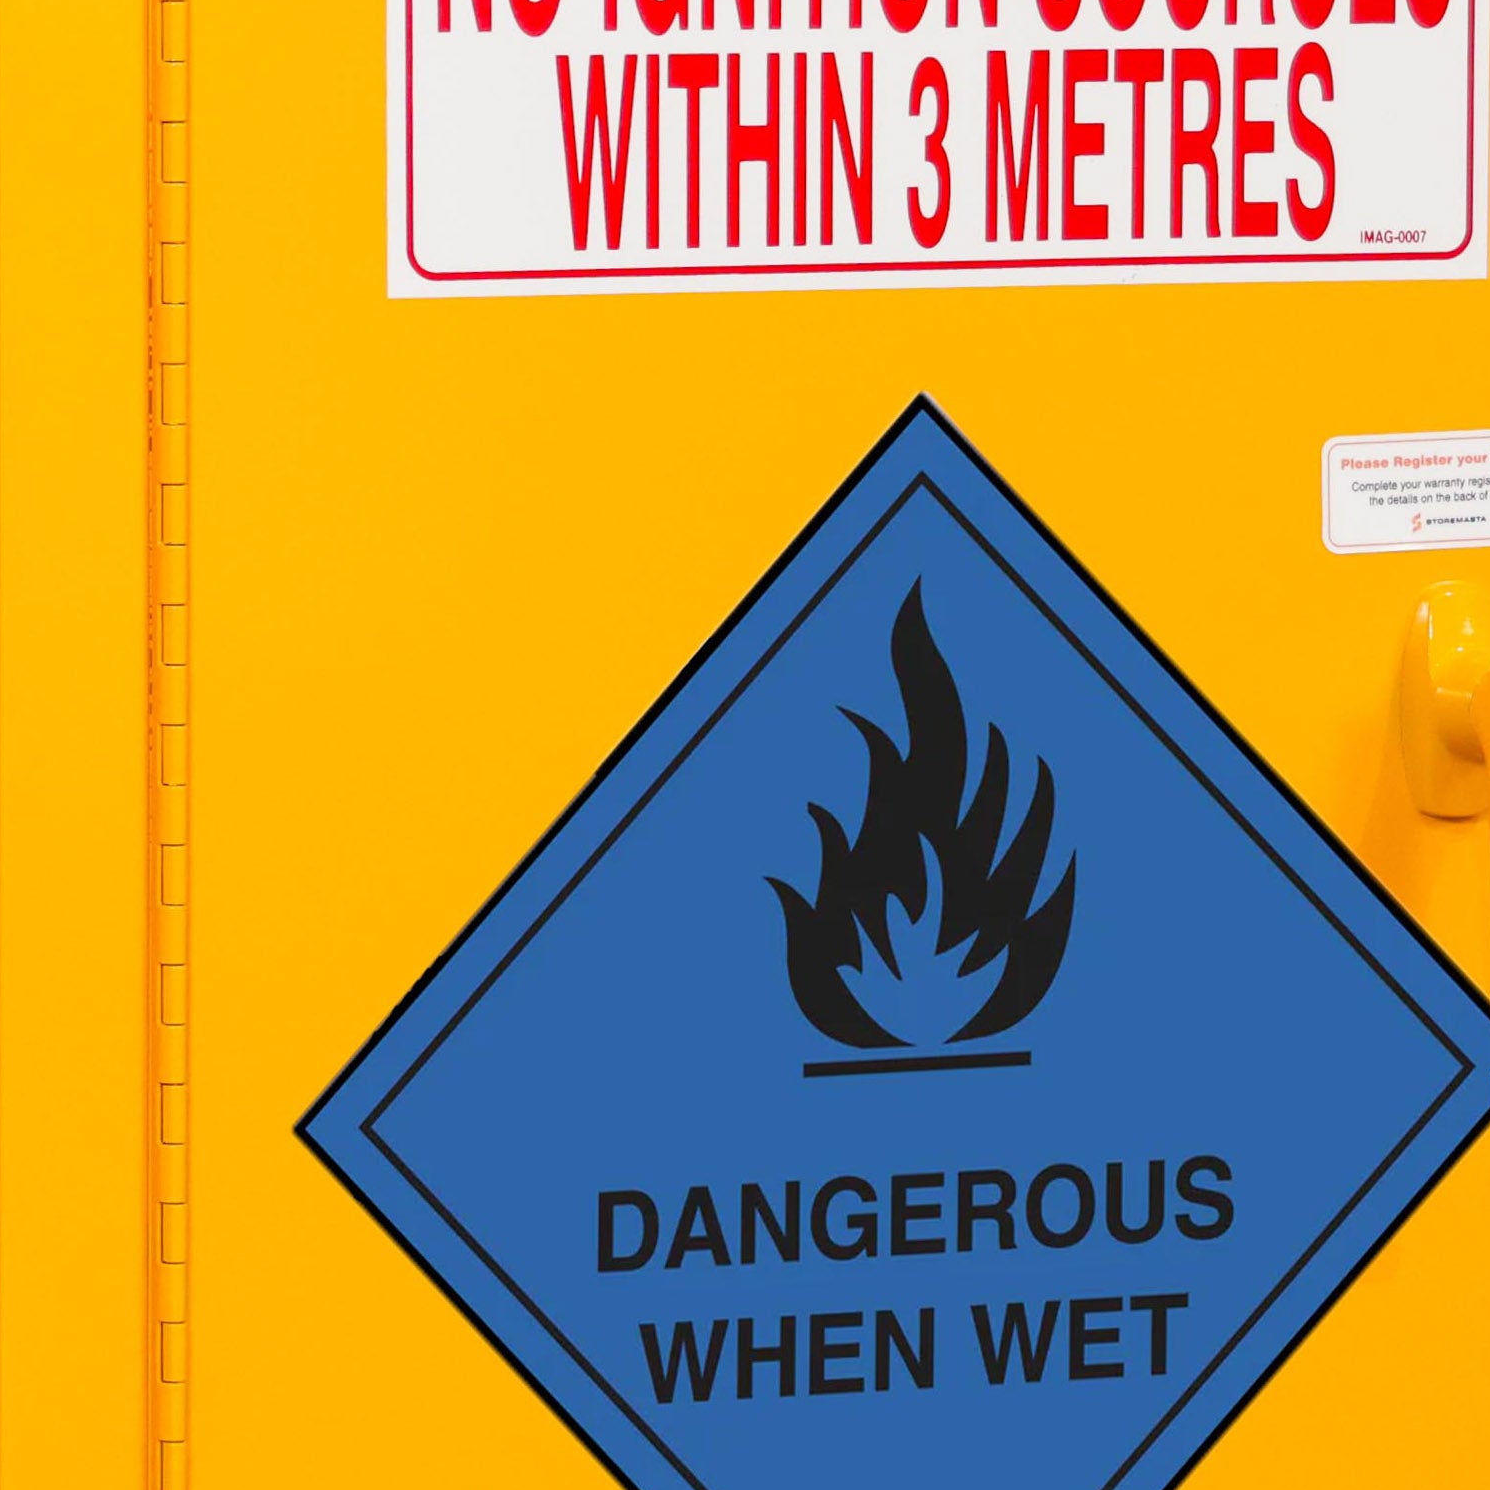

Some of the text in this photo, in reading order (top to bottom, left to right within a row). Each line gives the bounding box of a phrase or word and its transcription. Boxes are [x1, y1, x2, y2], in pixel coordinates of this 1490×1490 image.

[556, 42, 1335, 251] WITHIN 3 METRES
[1360, 230, 1427, 244] IMAG-0007
[1341, 458, 1389, 469] Please
[1394, 455, 1452, 469] Register
[1458, 454, 1487, 467] your
[1352, 481, 1397, 492] Complete
[1400, 481, 1421, 492] your
[1424, 478, 1465, 489] warranty
[1369, 495, 1384, 506] the
[1387, 494, 1418, 505] details
[1421, 494, 1433, 503] on
[1436, 493, 1451, 502] the
[1454, 491, 1476, 501] back
[1479, 490, 1488, 500] of
[1426, 516, 1486, 525] STOREMASTA
[597, 1154, 1236, 1272] DANGEROUS
[639, 1293, 1188, 1404] WHEN WET
